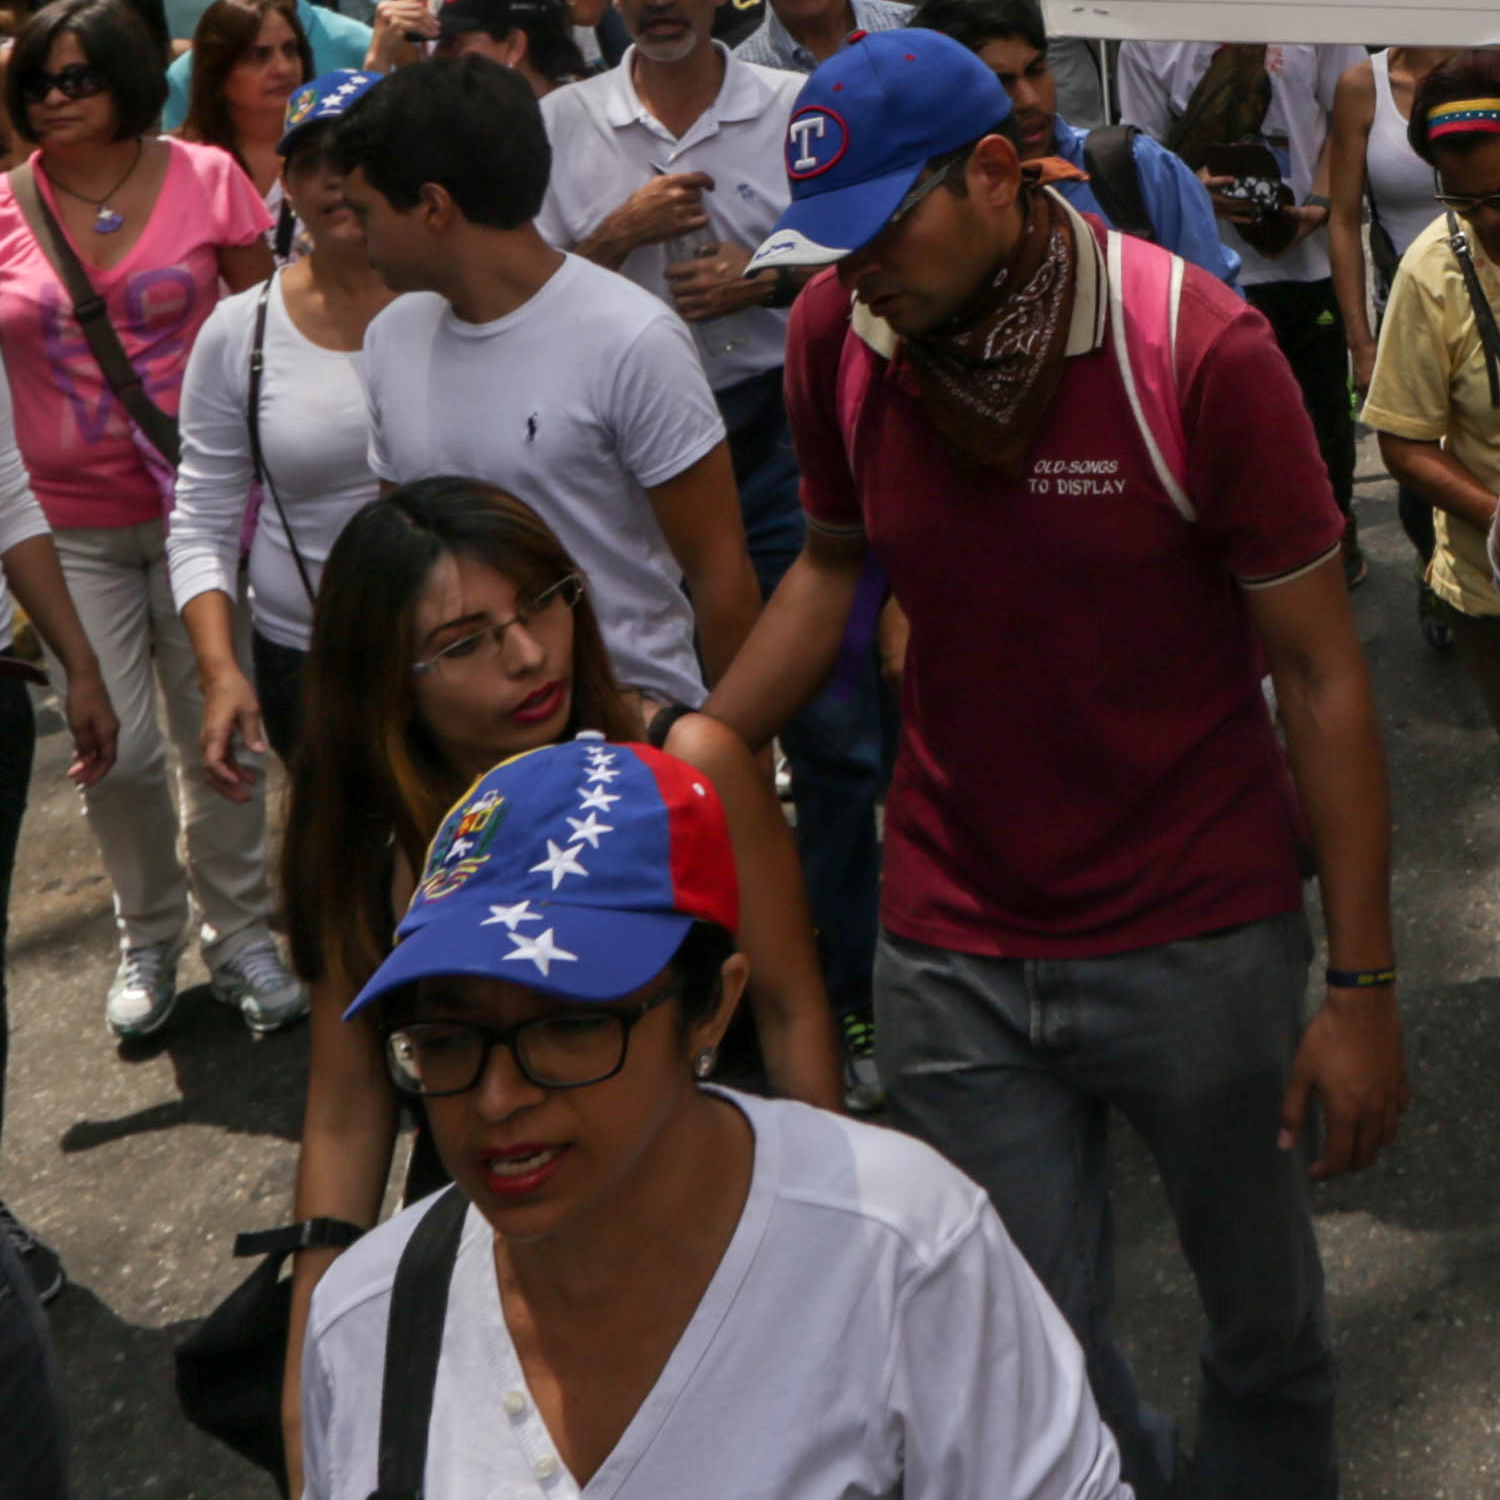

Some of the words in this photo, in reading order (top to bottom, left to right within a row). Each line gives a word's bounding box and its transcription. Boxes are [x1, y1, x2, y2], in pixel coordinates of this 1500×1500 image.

[790, 116, 825, 171] T
[1028, 479, 1049, 494] TO
[1057, 479, 1126, 495] DISPLAY
